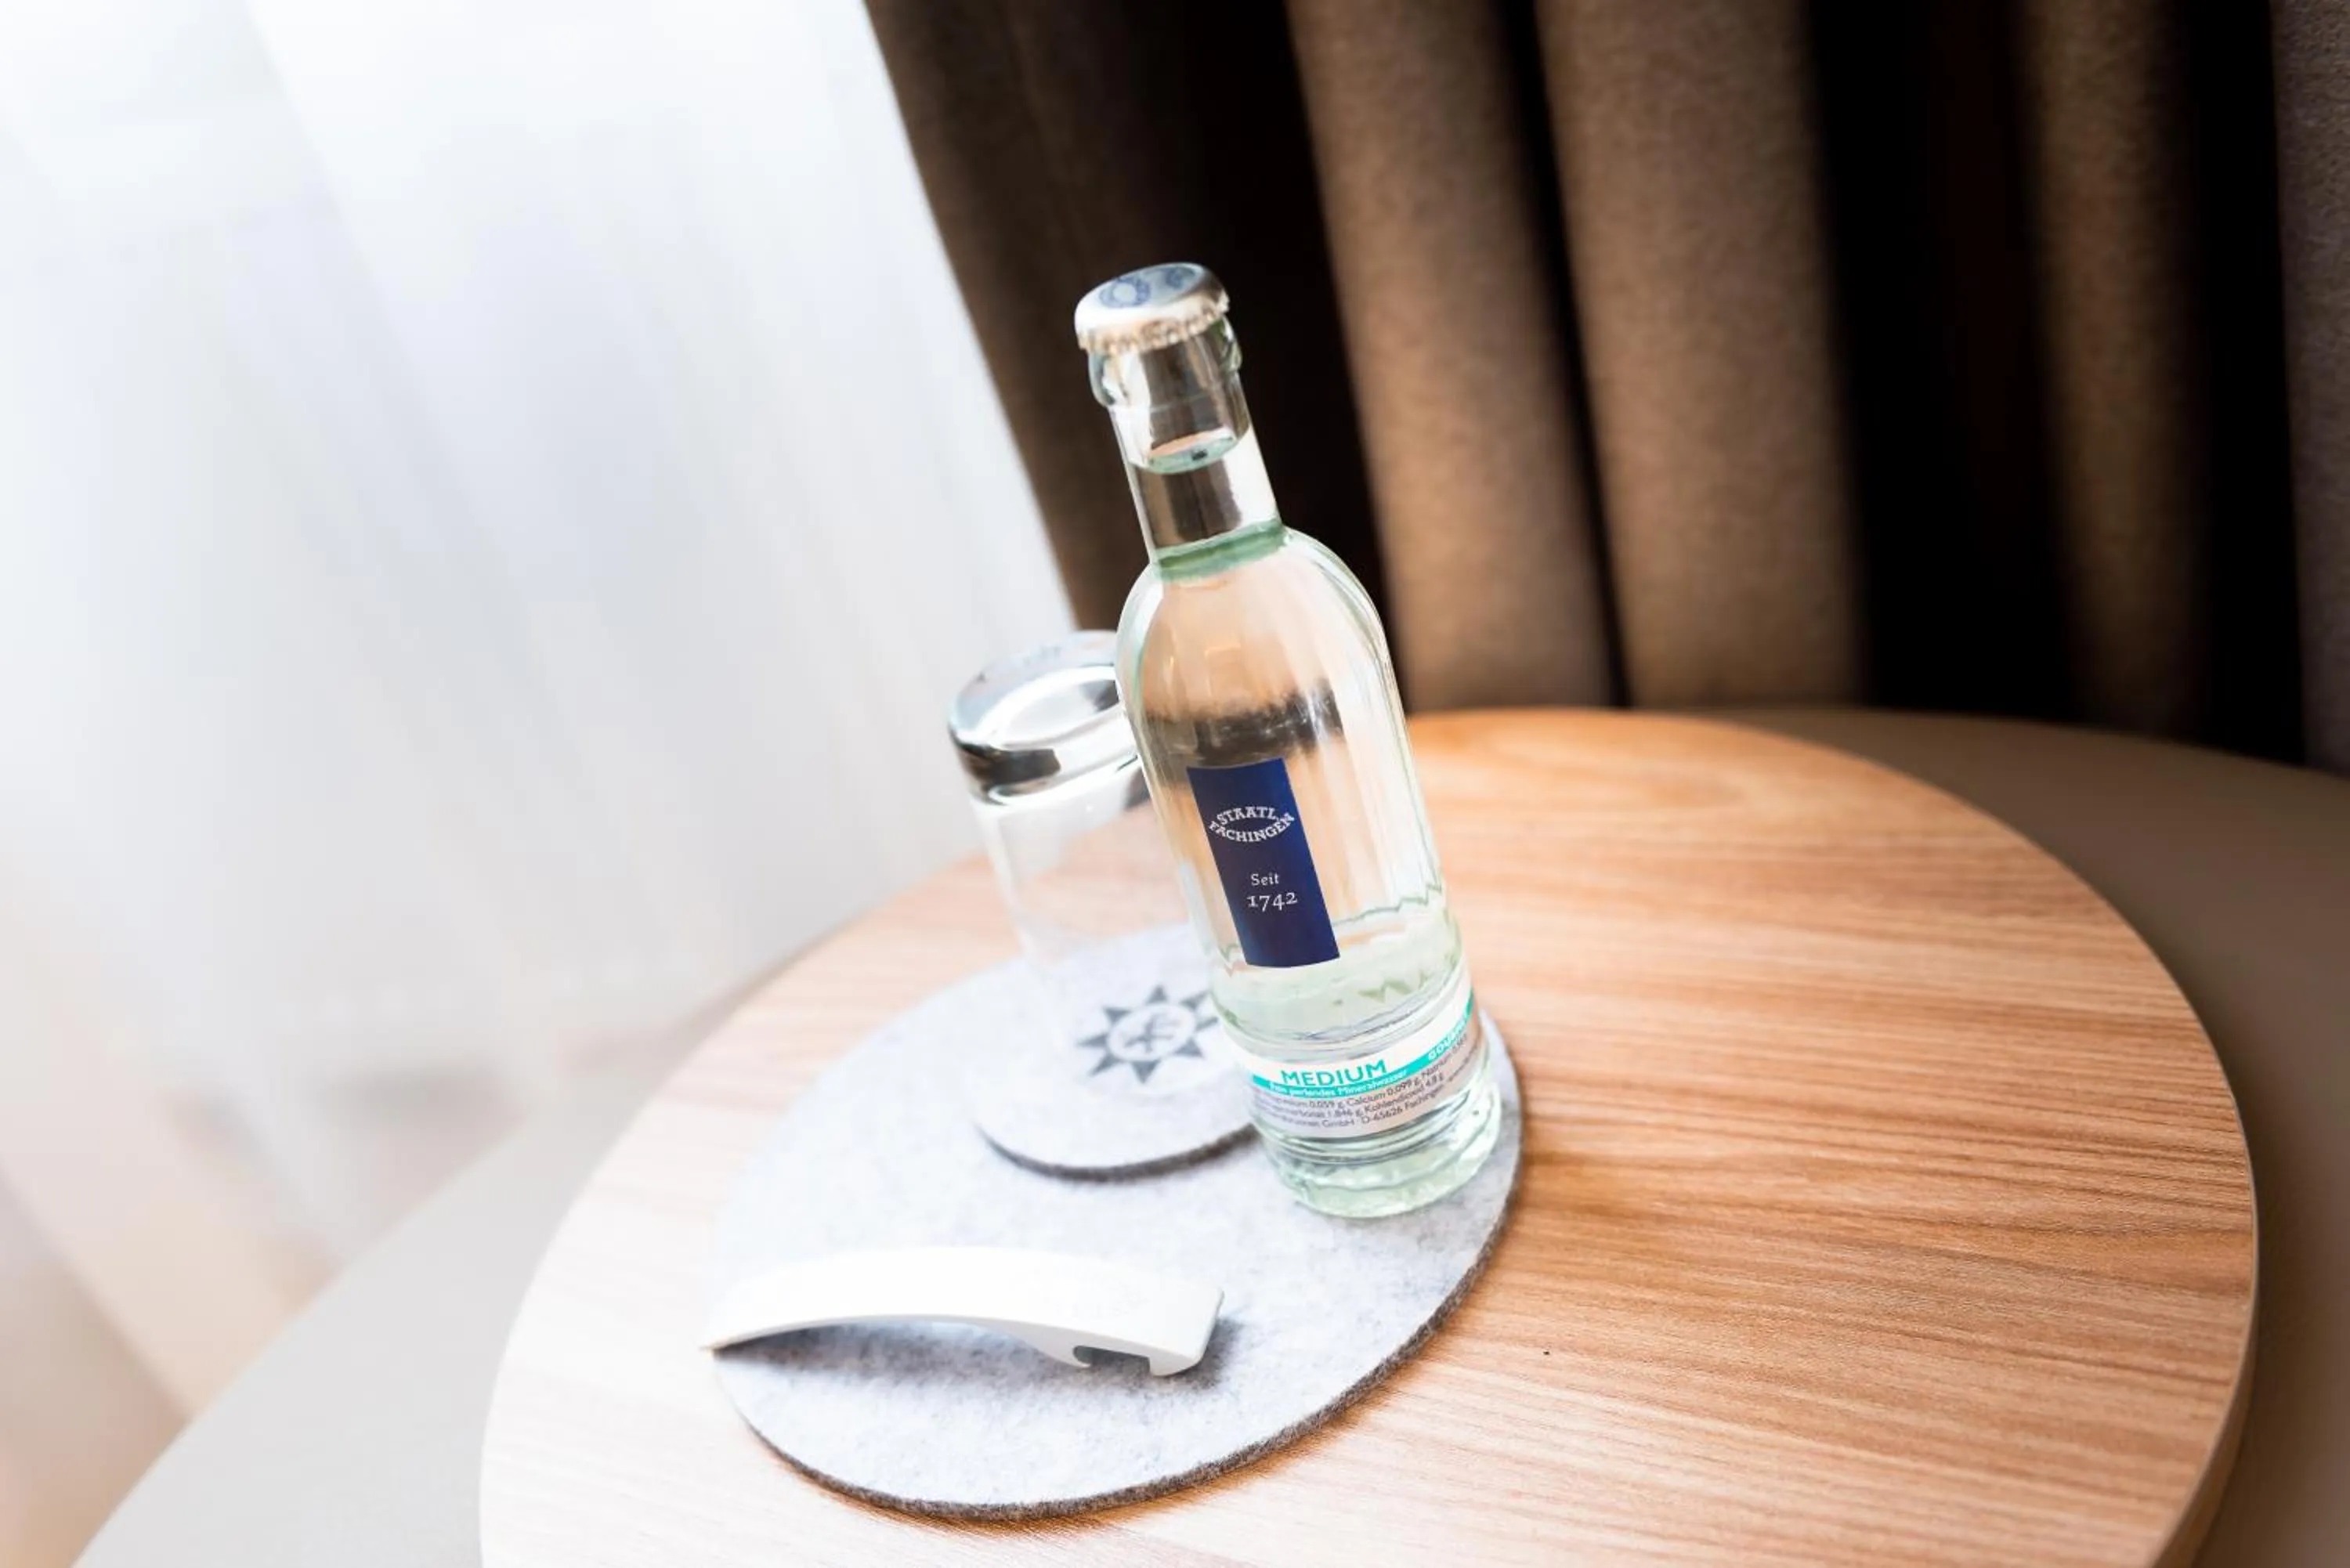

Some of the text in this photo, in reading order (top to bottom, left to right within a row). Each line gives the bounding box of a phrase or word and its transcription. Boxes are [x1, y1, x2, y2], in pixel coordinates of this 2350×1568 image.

[1209, 812, 1295, 843] FACHINGEN
[1250, 872, 1280, 886] Seit
[1246, 891, 1299, 912] 1742
[1279, 1058, 1387, 1086] MEDIUM
[1347, 1091, 1386, 1106] Calcium
[1321, 1118, 1355, 1128] GmbH
